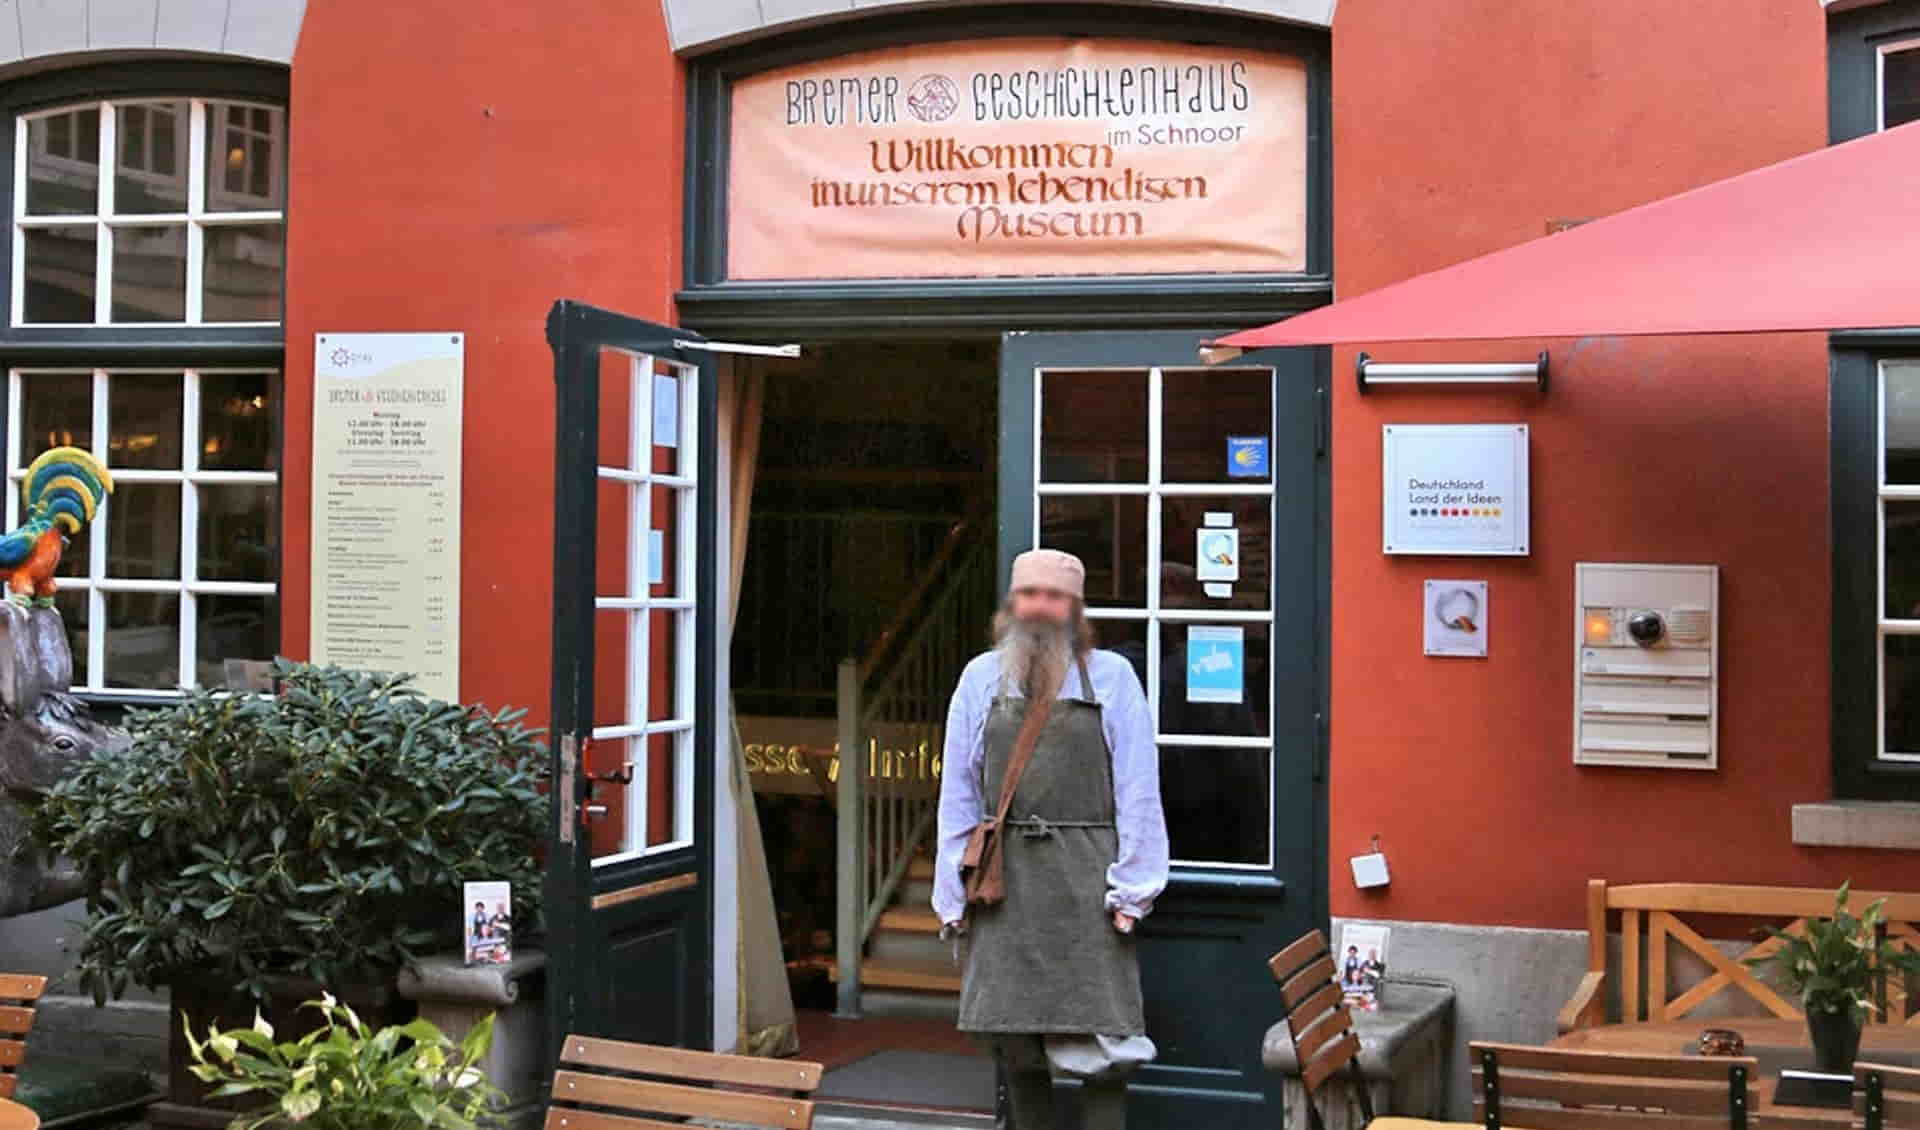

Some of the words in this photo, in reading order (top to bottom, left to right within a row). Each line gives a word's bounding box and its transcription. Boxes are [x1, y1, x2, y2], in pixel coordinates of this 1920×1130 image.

[1108, 127, 1132, 147] im
[1138, 123, 1244, 146] Schnoor
[869, 137, 1114, 173] Willkommen
[957, 205, 1143, 244] Museum
[1409, 479, 1484, 490] Deutschland
[1409, 493, 1438, 504] Land
[1442, 493, 1464, 504] der
[1466, 493, 1502, 504] Ideen
